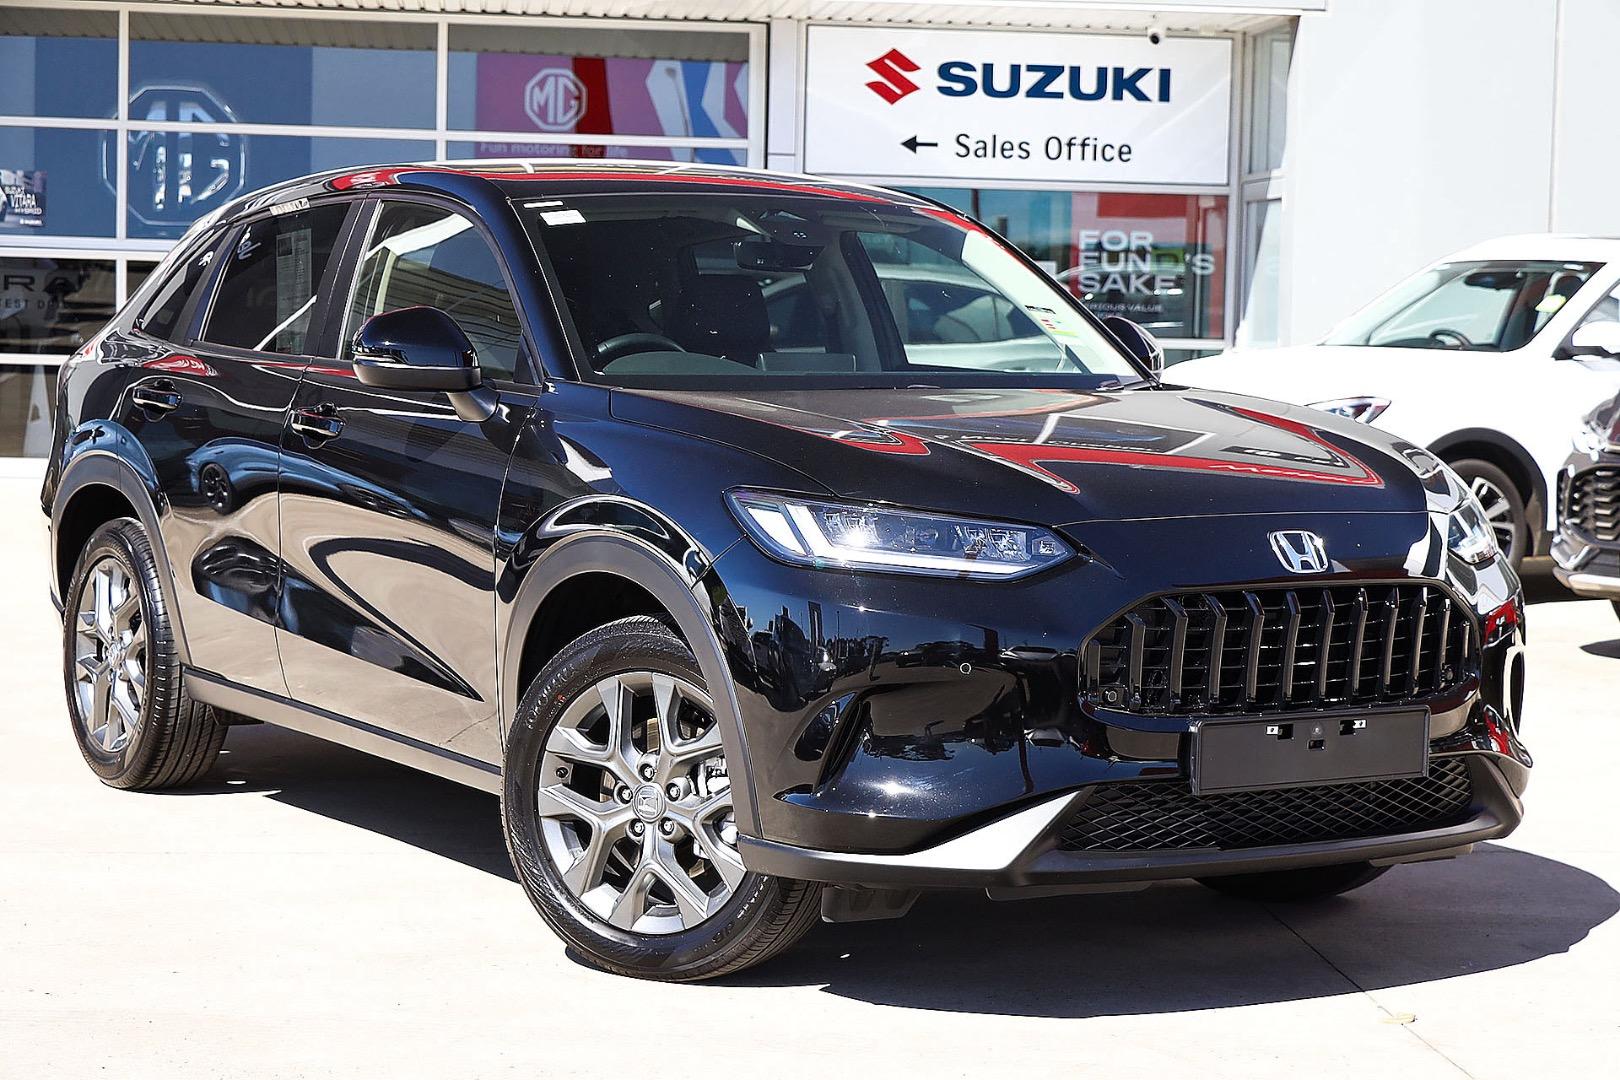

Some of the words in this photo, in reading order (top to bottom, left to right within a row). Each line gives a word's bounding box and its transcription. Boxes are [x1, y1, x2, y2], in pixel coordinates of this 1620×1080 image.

[936, 60, 1172, 103] SUZUKI
[531, 75, 581, 124] MG
[954, 133, 1032, 161] Sales
[1044, 136, 1133, 163] Office
[1078, 229, 1153, 252] FOR
[1077, 272, 1177, 296] SAKE
